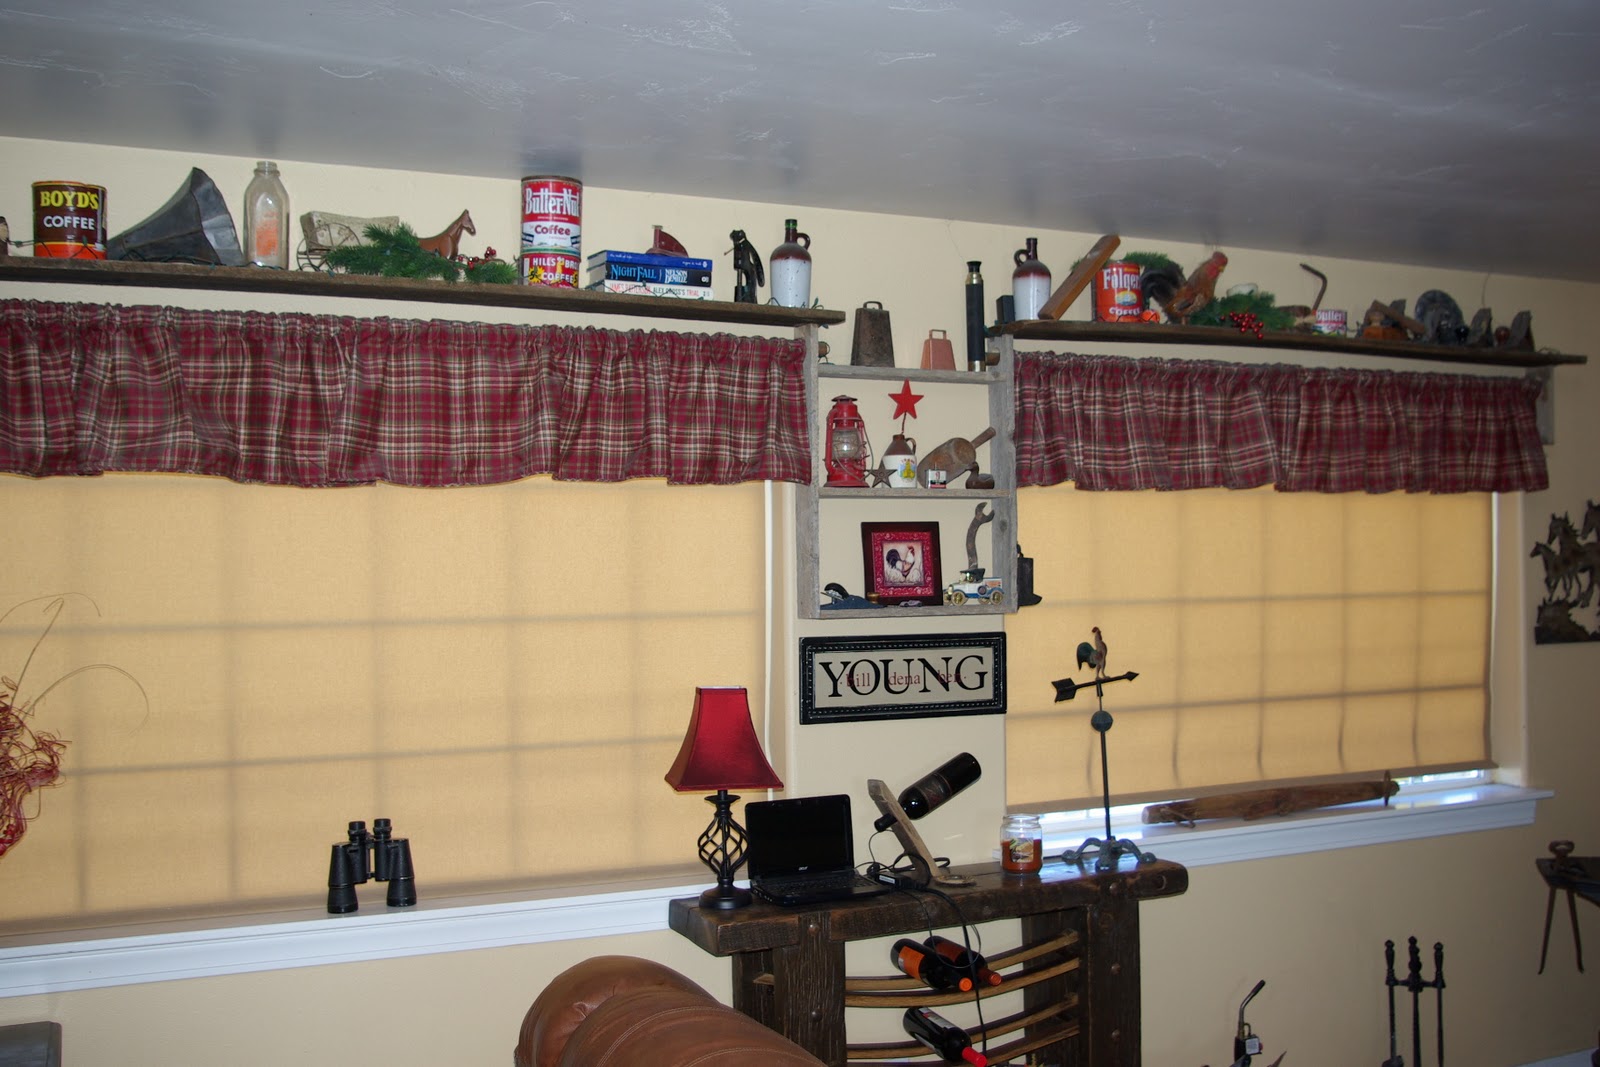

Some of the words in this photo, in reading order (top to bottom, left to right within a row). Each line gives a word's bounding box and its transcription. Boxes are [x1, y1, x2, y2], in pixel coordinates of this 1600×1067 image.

[40, 190, 99, 210] BOYD'S
[43, 215, 95, 230] COFFEE
[534, 224, 571, 236] Coffee
[532, 257, 556, 267] HILLS
[541, 272, 575, 284] COFFEE
[819, 655, 988, 698] YOUNG
[888, 672, 921, 686] dena
